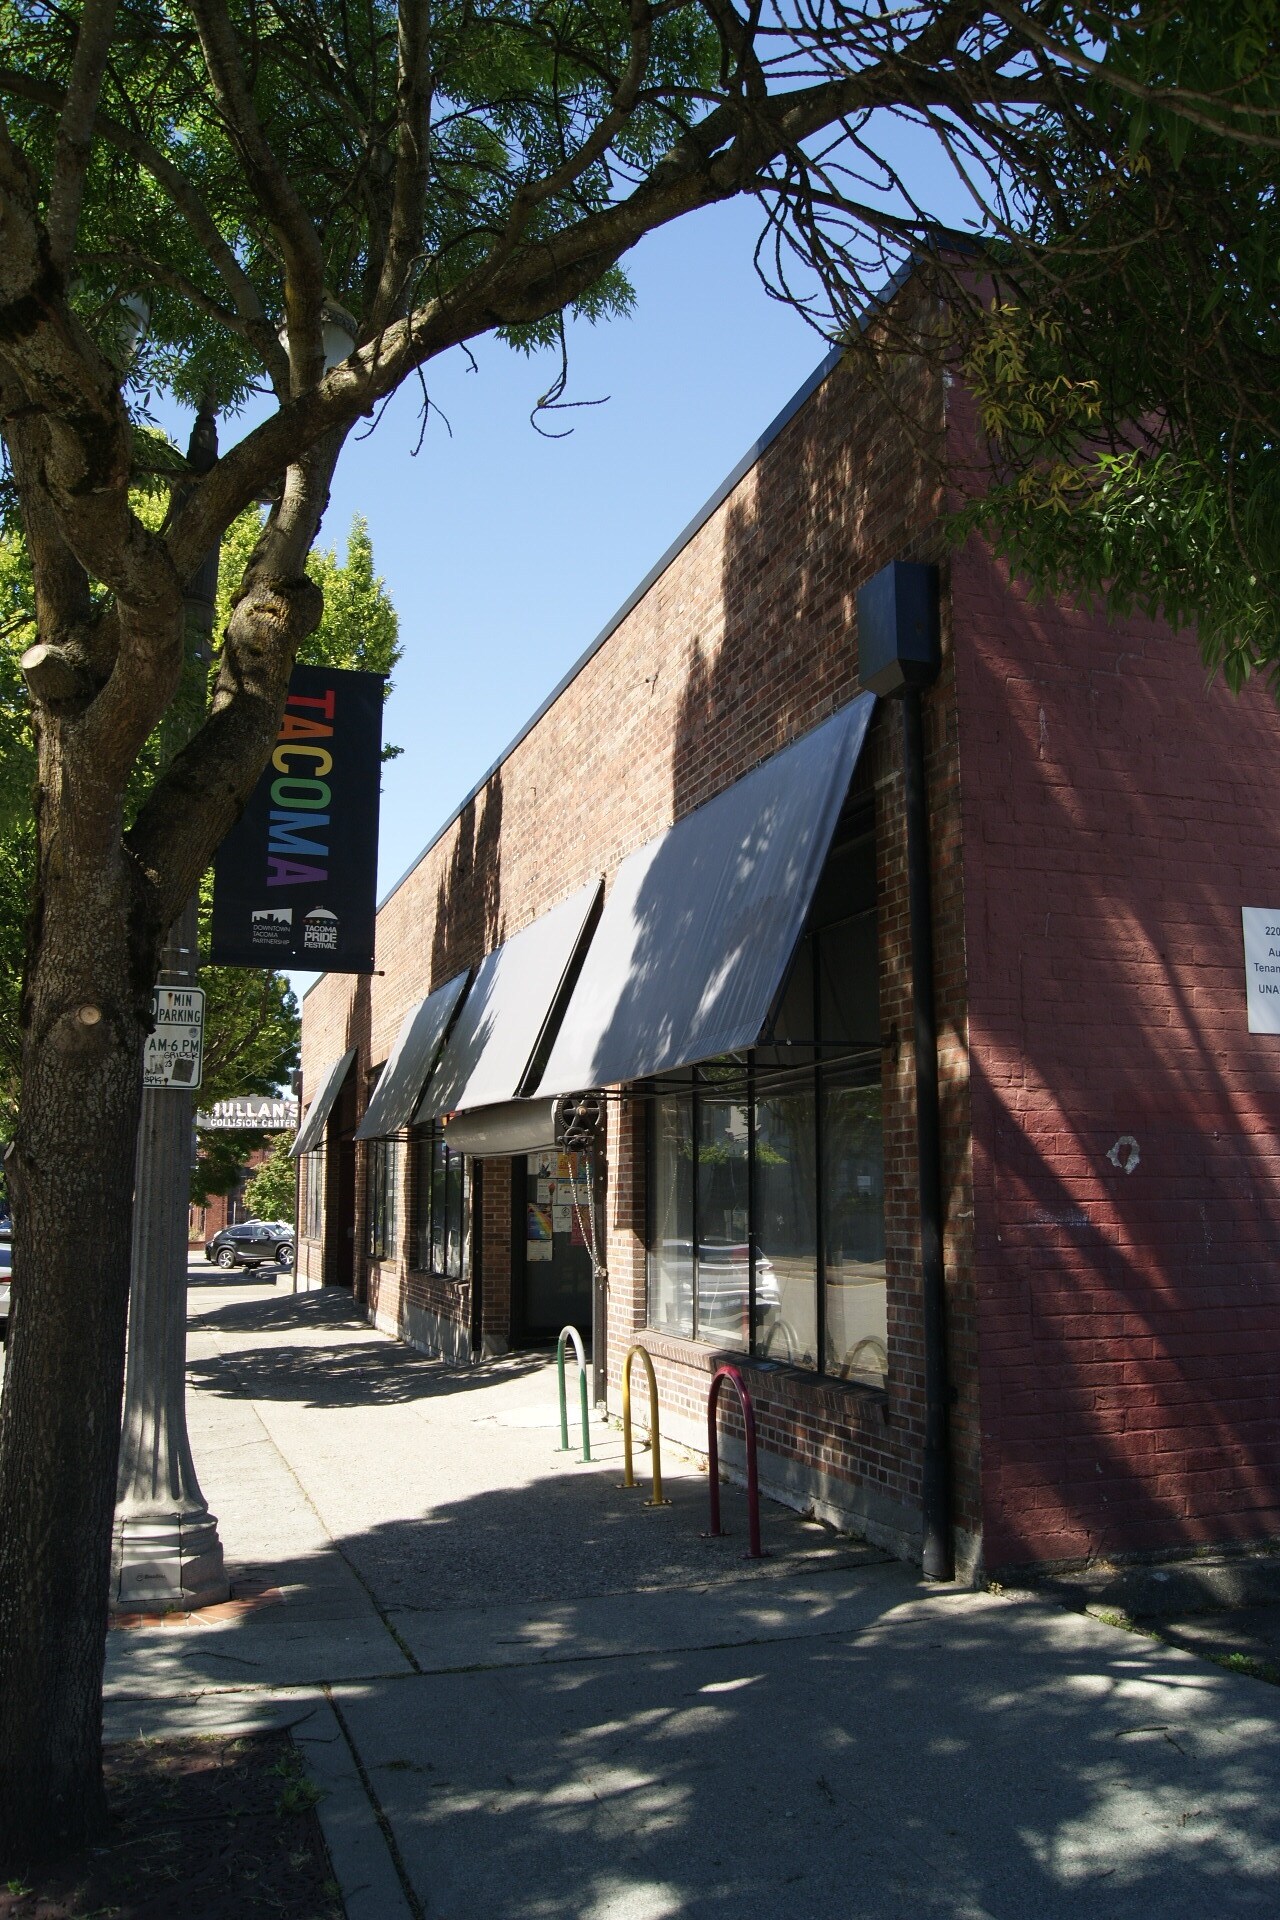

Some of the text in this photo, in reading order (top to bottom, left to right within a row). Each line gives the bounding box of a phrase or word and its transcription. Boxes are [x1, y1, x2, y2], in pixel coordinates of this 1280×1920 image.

[267, 690, 335, 887] TACOMA
[305, 925, 336, 933] TACOMA
[305, 932, 336, 942] PRIDE
[173, 994, 192, 1007] MIN
[158, 1008, 201, 1023] PARKING
[183, 1040, 199, 1052] PM
[211, 1118, 297, 1128] COLLISION CENTER
